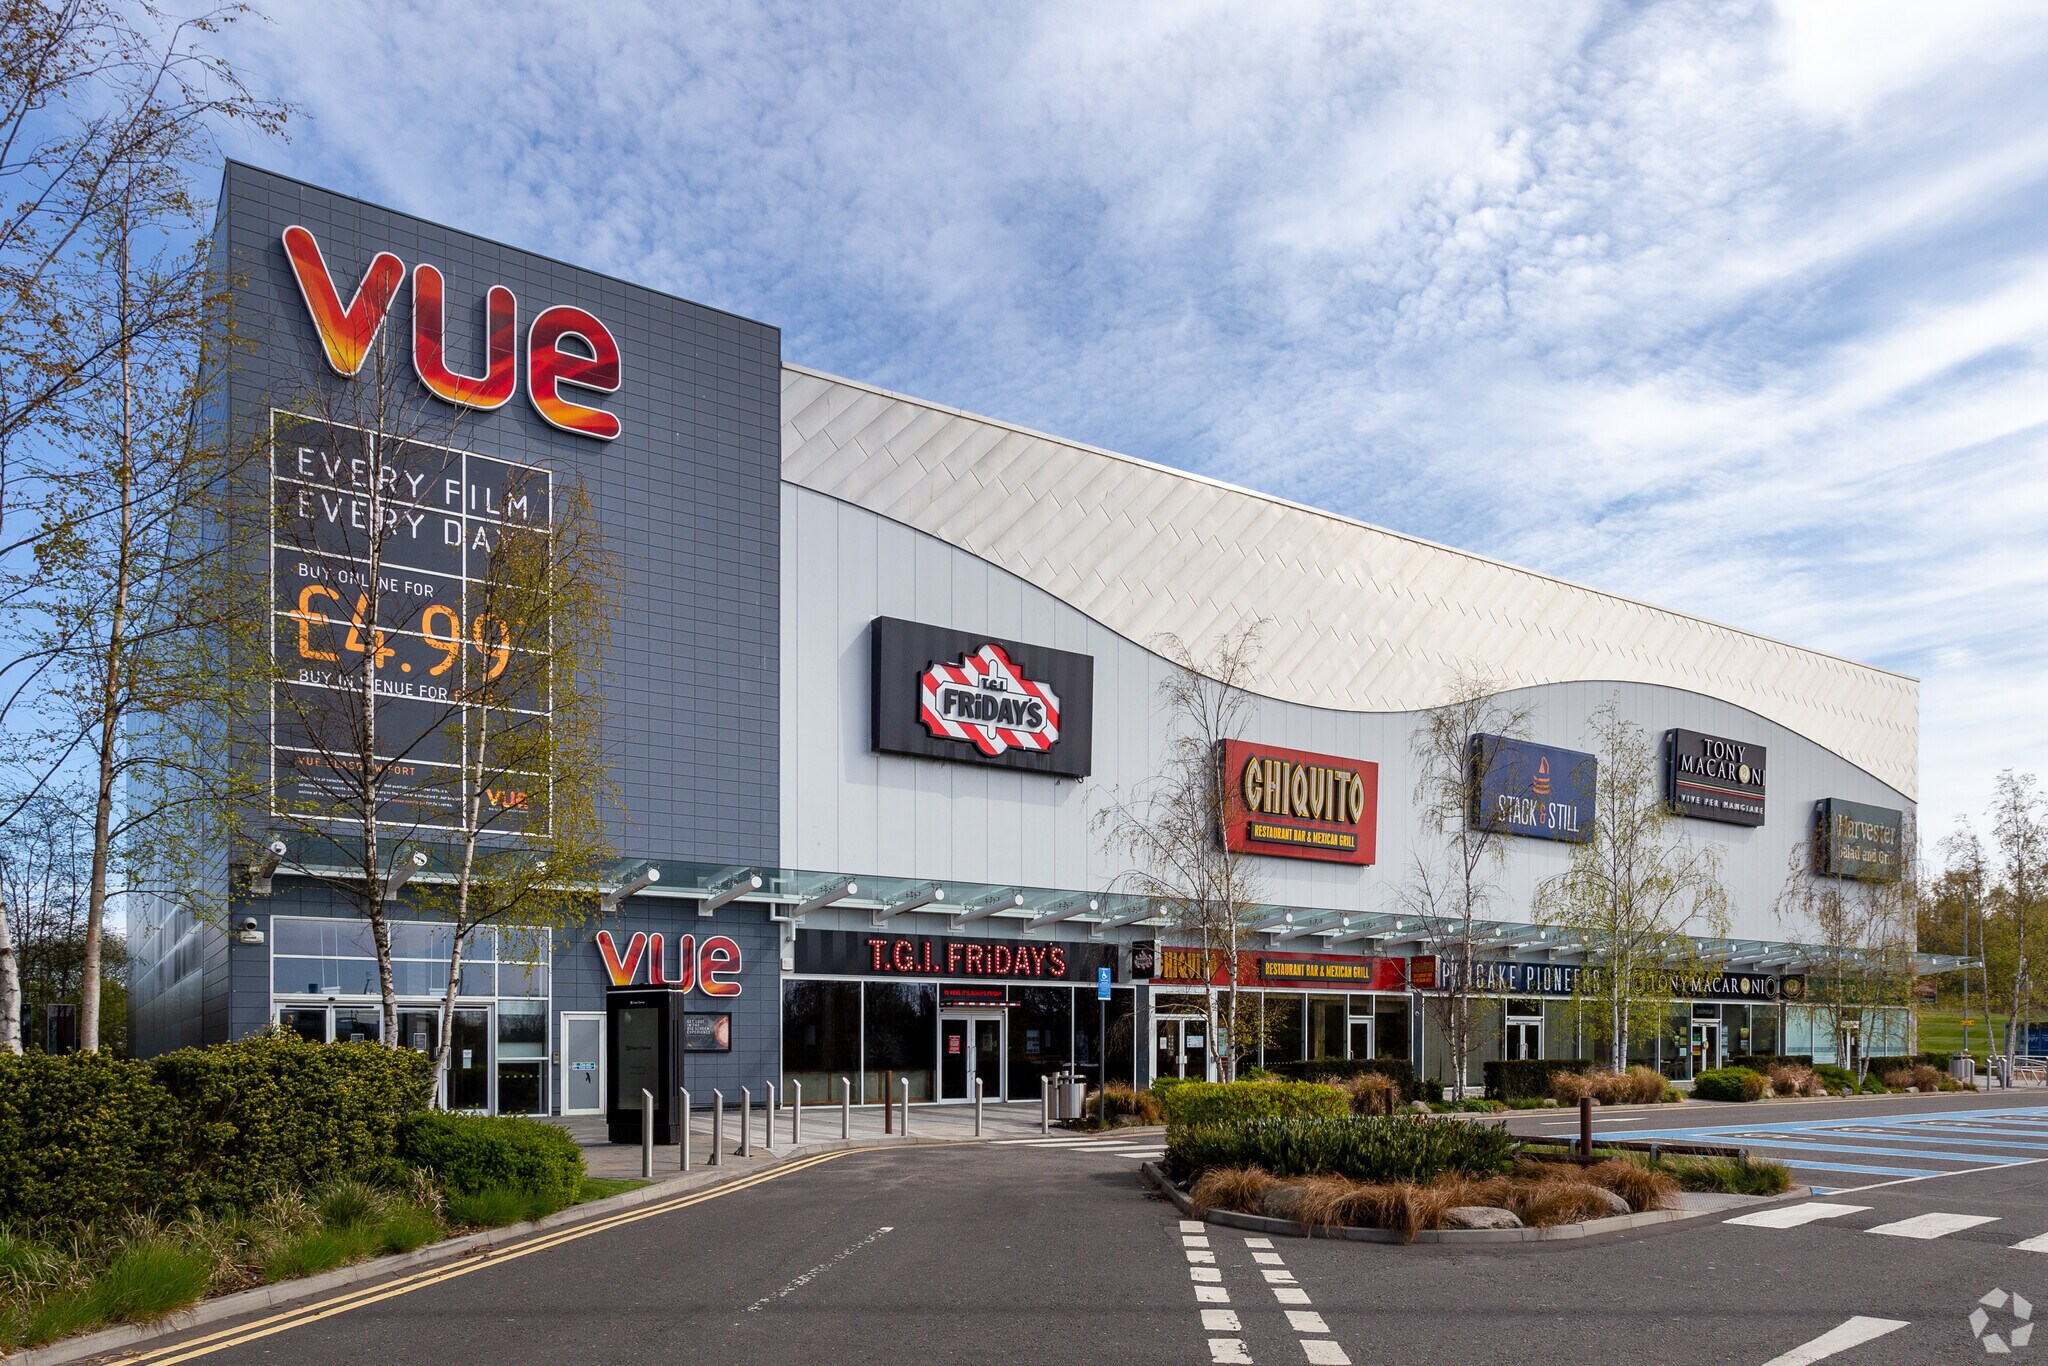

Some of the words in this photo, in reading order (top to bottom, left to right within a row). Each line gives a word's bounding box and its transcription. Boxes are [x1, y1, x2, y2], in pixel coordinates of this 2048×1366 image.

[298, 447, 425, 498] EVERY
[445, 479, 528, 520] FILM
[298, 490, 425, 539] EVERY
[298, 562, 332, 581] BUY
[338, 570, 399, 593] ONLNE
[405, 581, 434, 598] FOR
[299, 669, 332, 685] BUY
[339, 674, 354, 688] IN
[420, 686, 448, 701] FOR
[981, 677, 1007, 692] T.G.I.
[1704, 738, 1746, 763] TONY
[1245, 756, 1366, 825] CHIQUITO
[1681, 794, 1700, 805] VIVE
[1704, 798, 1720, 808] PER
[1722, 801, 1764, 815] MANGIARE
[1498, 794, 1537, 827] STACK
[1539, 804, 1546, 824] &
[1548, 802, 1580, 833] STILL
[1838, 814, 1896, 845] Harvester
[1254, 825, 1293, 841] RESTAURANT
[1293, 830, 1306, 842] BAR
[1306, 831, 1311, 843] &
[1312, 832, 1338, 847] MEXICAN
[1339, 835, 1355, 848] GRILL
[867, 938, 941, 973] T.G.I.
[1264, 961, 1305, 977] RESTAURANT
[1305, 963, 1318, 977] BAR
[1319, 965, 1325, 978] &
[1326, 965, 1352, 979] MEXICAN
[1353, 965, 1370, 980] GRILL
